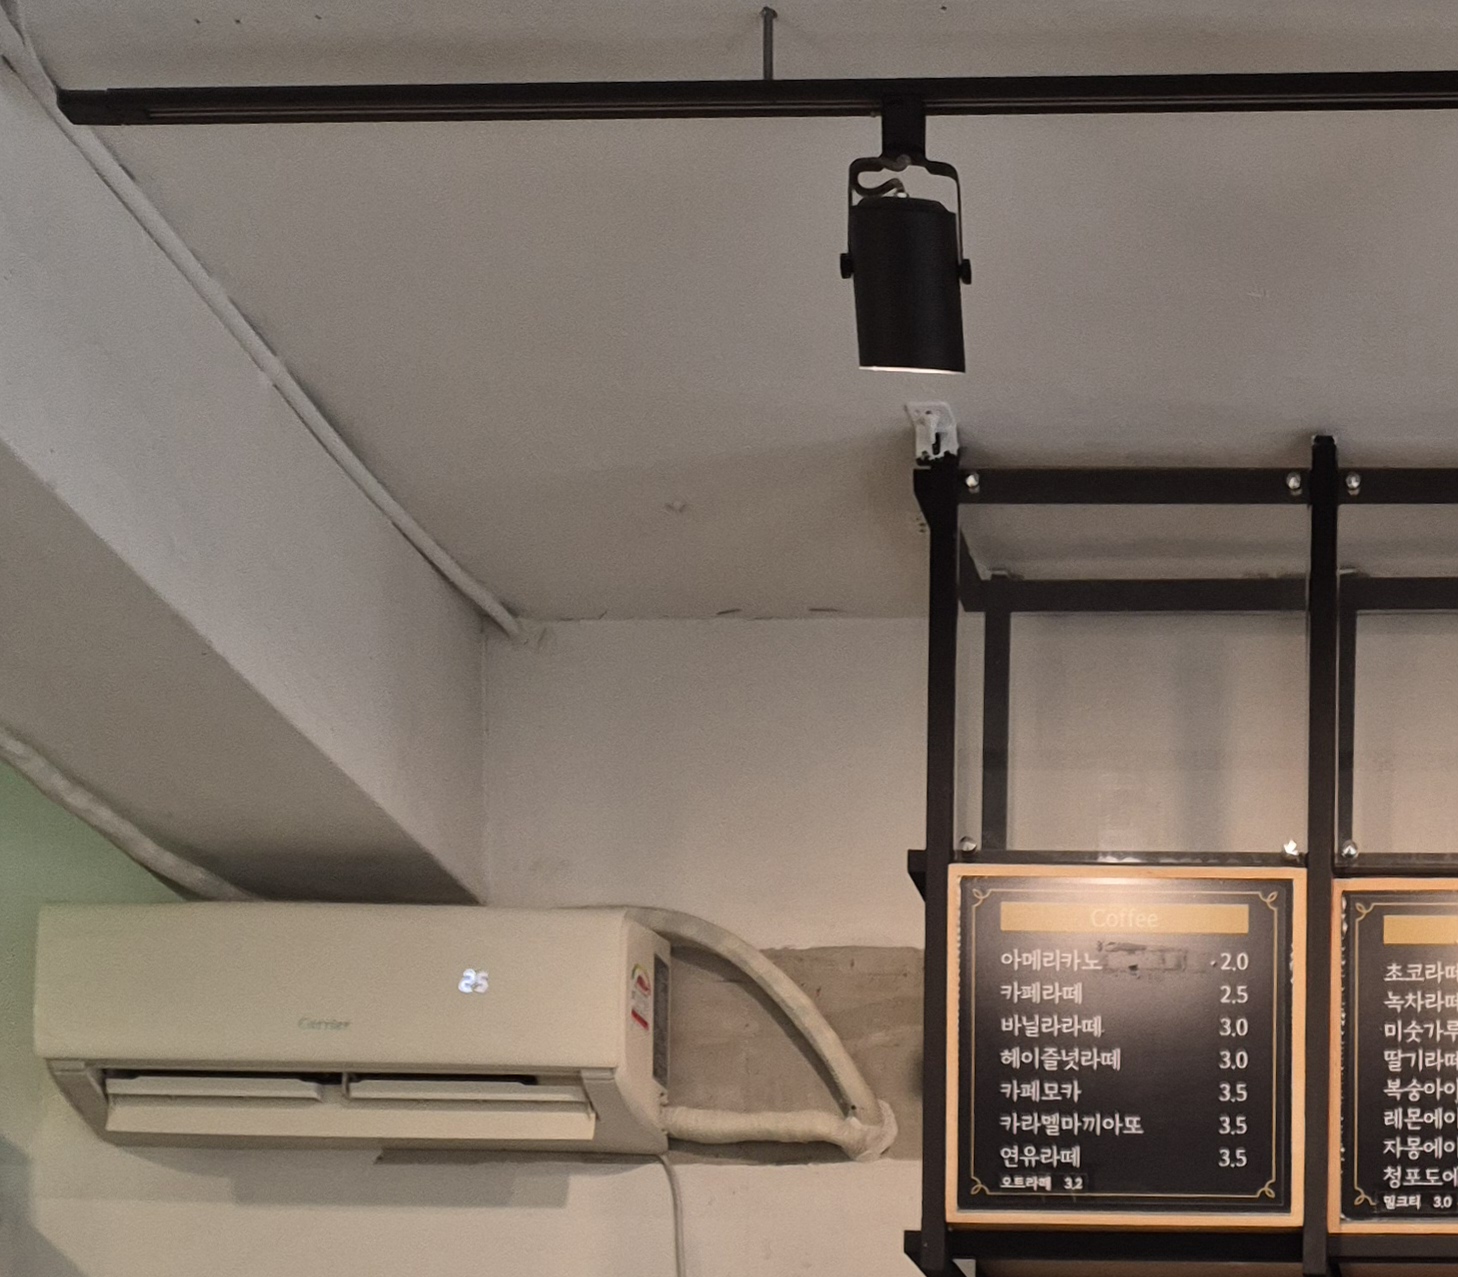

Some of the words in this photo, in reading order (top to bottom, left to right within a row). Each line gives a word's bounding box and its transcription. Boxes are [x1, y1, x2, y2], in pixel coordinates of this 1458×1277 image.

[1090, 908, 1159, 929] Coffee
[1000, 949, 1103, 972] 아메리카노
[1220, 952, 1249, 971] 2.0
[458, 968, 489, 993] 25
[1000, 981, 1083, 1004] 카페라떼
[1219, 985, 1249, 1004] 2.5
[1000, 1014, 1103, 1037] 바닐라라떼
[1218, 1018, 1249, 1037] 3.0
[1000, 1048, 1121, 1072] 헤이즐넛라떼
[1218, 1050, 1248, 1070] 3.0
[999, 1080, 1082, 1104] 카페모카
[1218, 1083, 1248, 1103] 3.5
[999, 1112, 1145, 1136] 카라멜마끼아또
[1218, 1116, 1248, 1135] 3.5
[1000, 1145, 1081, 1169] 연유라떼
[1218, 1148, 1248, 1168] 3.5
[1433, 1195, 1453, 1209] 3.0
